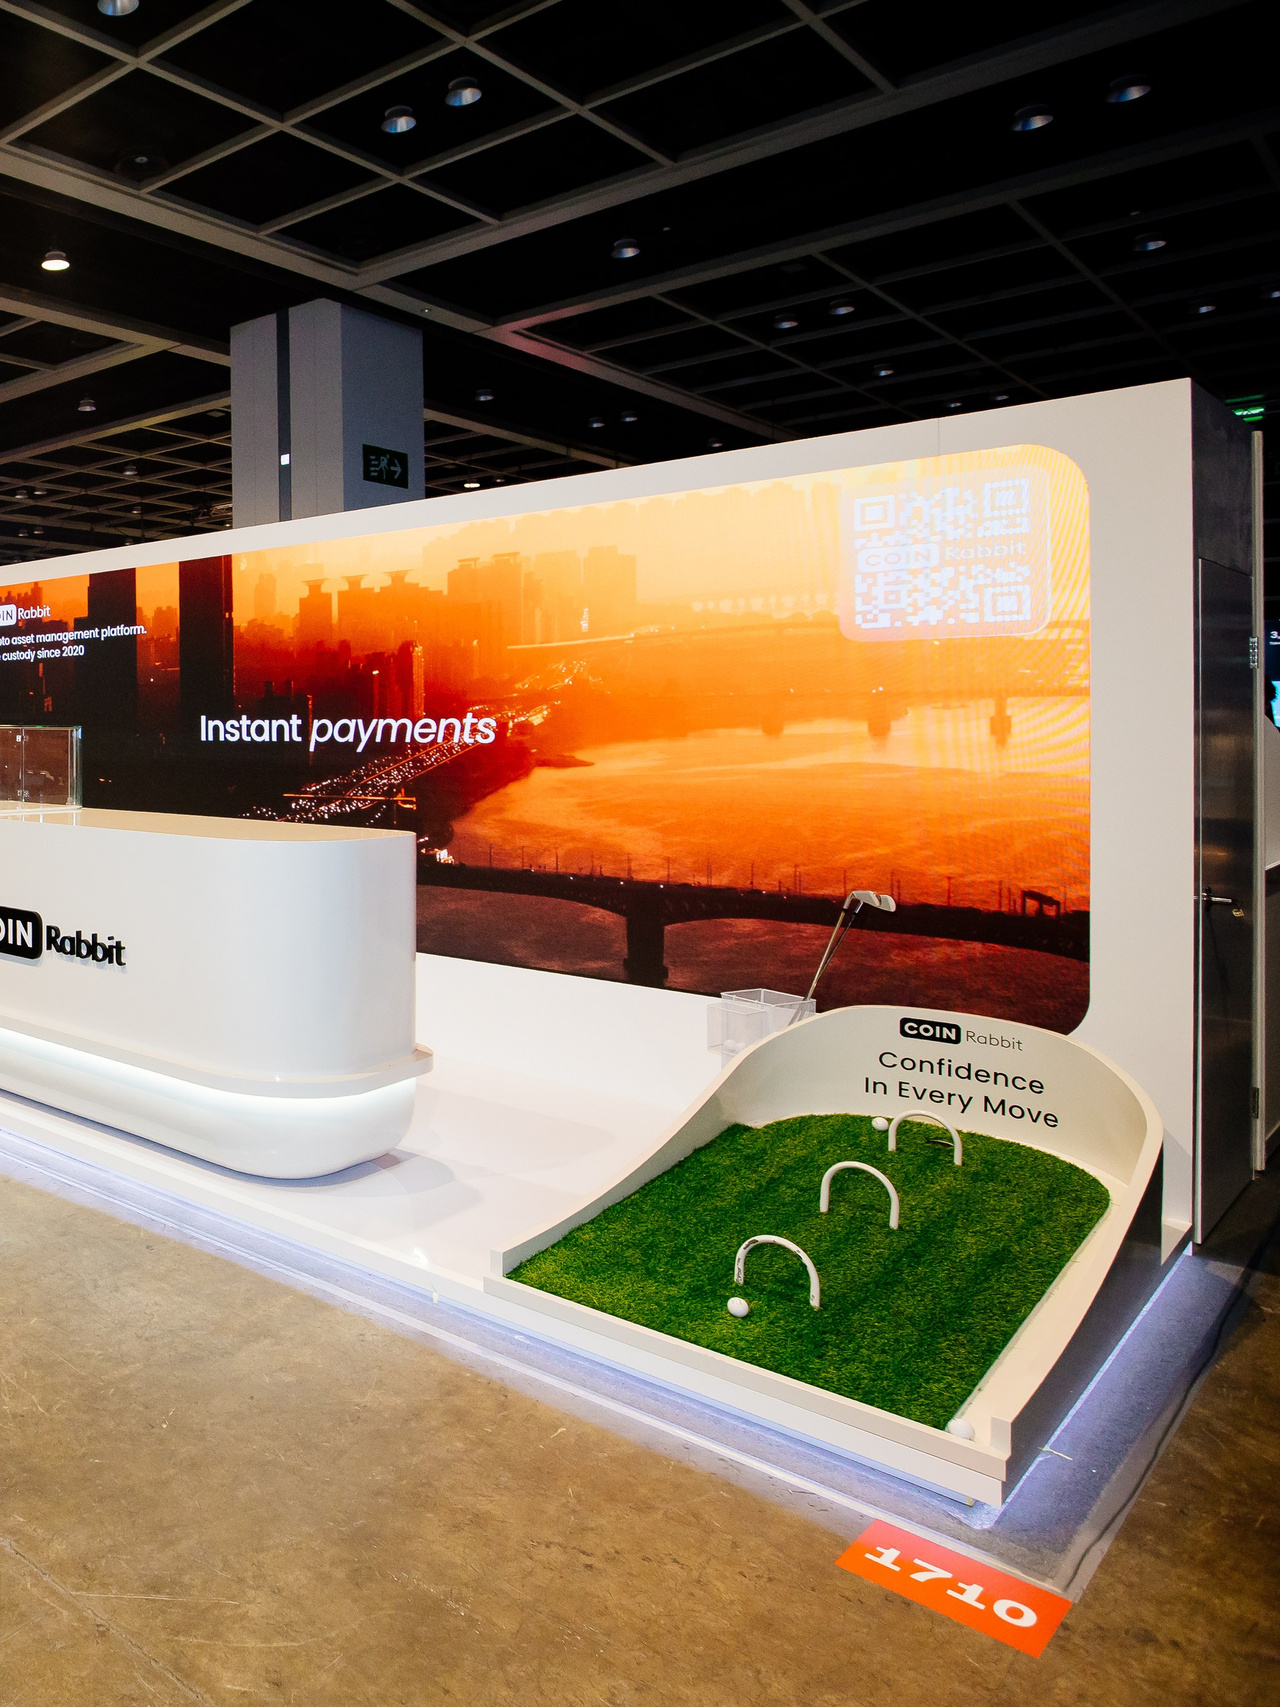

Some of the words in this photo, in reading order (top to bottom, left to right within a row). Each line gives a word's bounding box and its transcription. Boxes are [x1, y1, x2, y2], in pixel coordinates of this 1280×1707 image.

[865, 549, 931, 567] COIN
[944, 541, 1026, 561] Rabbit
[18, 605, 51, 619] Rabbit
[11, 634, 35, 645] asset
[36, 628, 100, 644] management
[101, 624, 147, 641] platform.
[2, 648, 36, 662] custody
[37, 648, 61, 659] since
[62, 645, 85, 657] 2020
[200, 715, 302, 742] Instant
[309, 712, 497, 752] payments
[46, 925, 126, 966] Rabbit
[904, 1022, 957, 1041] COIN
[966, 1030, 1023, 1051] Rabbit
[878, 1052, 1045, 1094] Confidence
[864, 1077, 888, 1095] In
[898, 1081, 974, 1114] Every
[983, 1095, 1059, 1128] Move
[864, 1546, 1038, 1627] 1710
